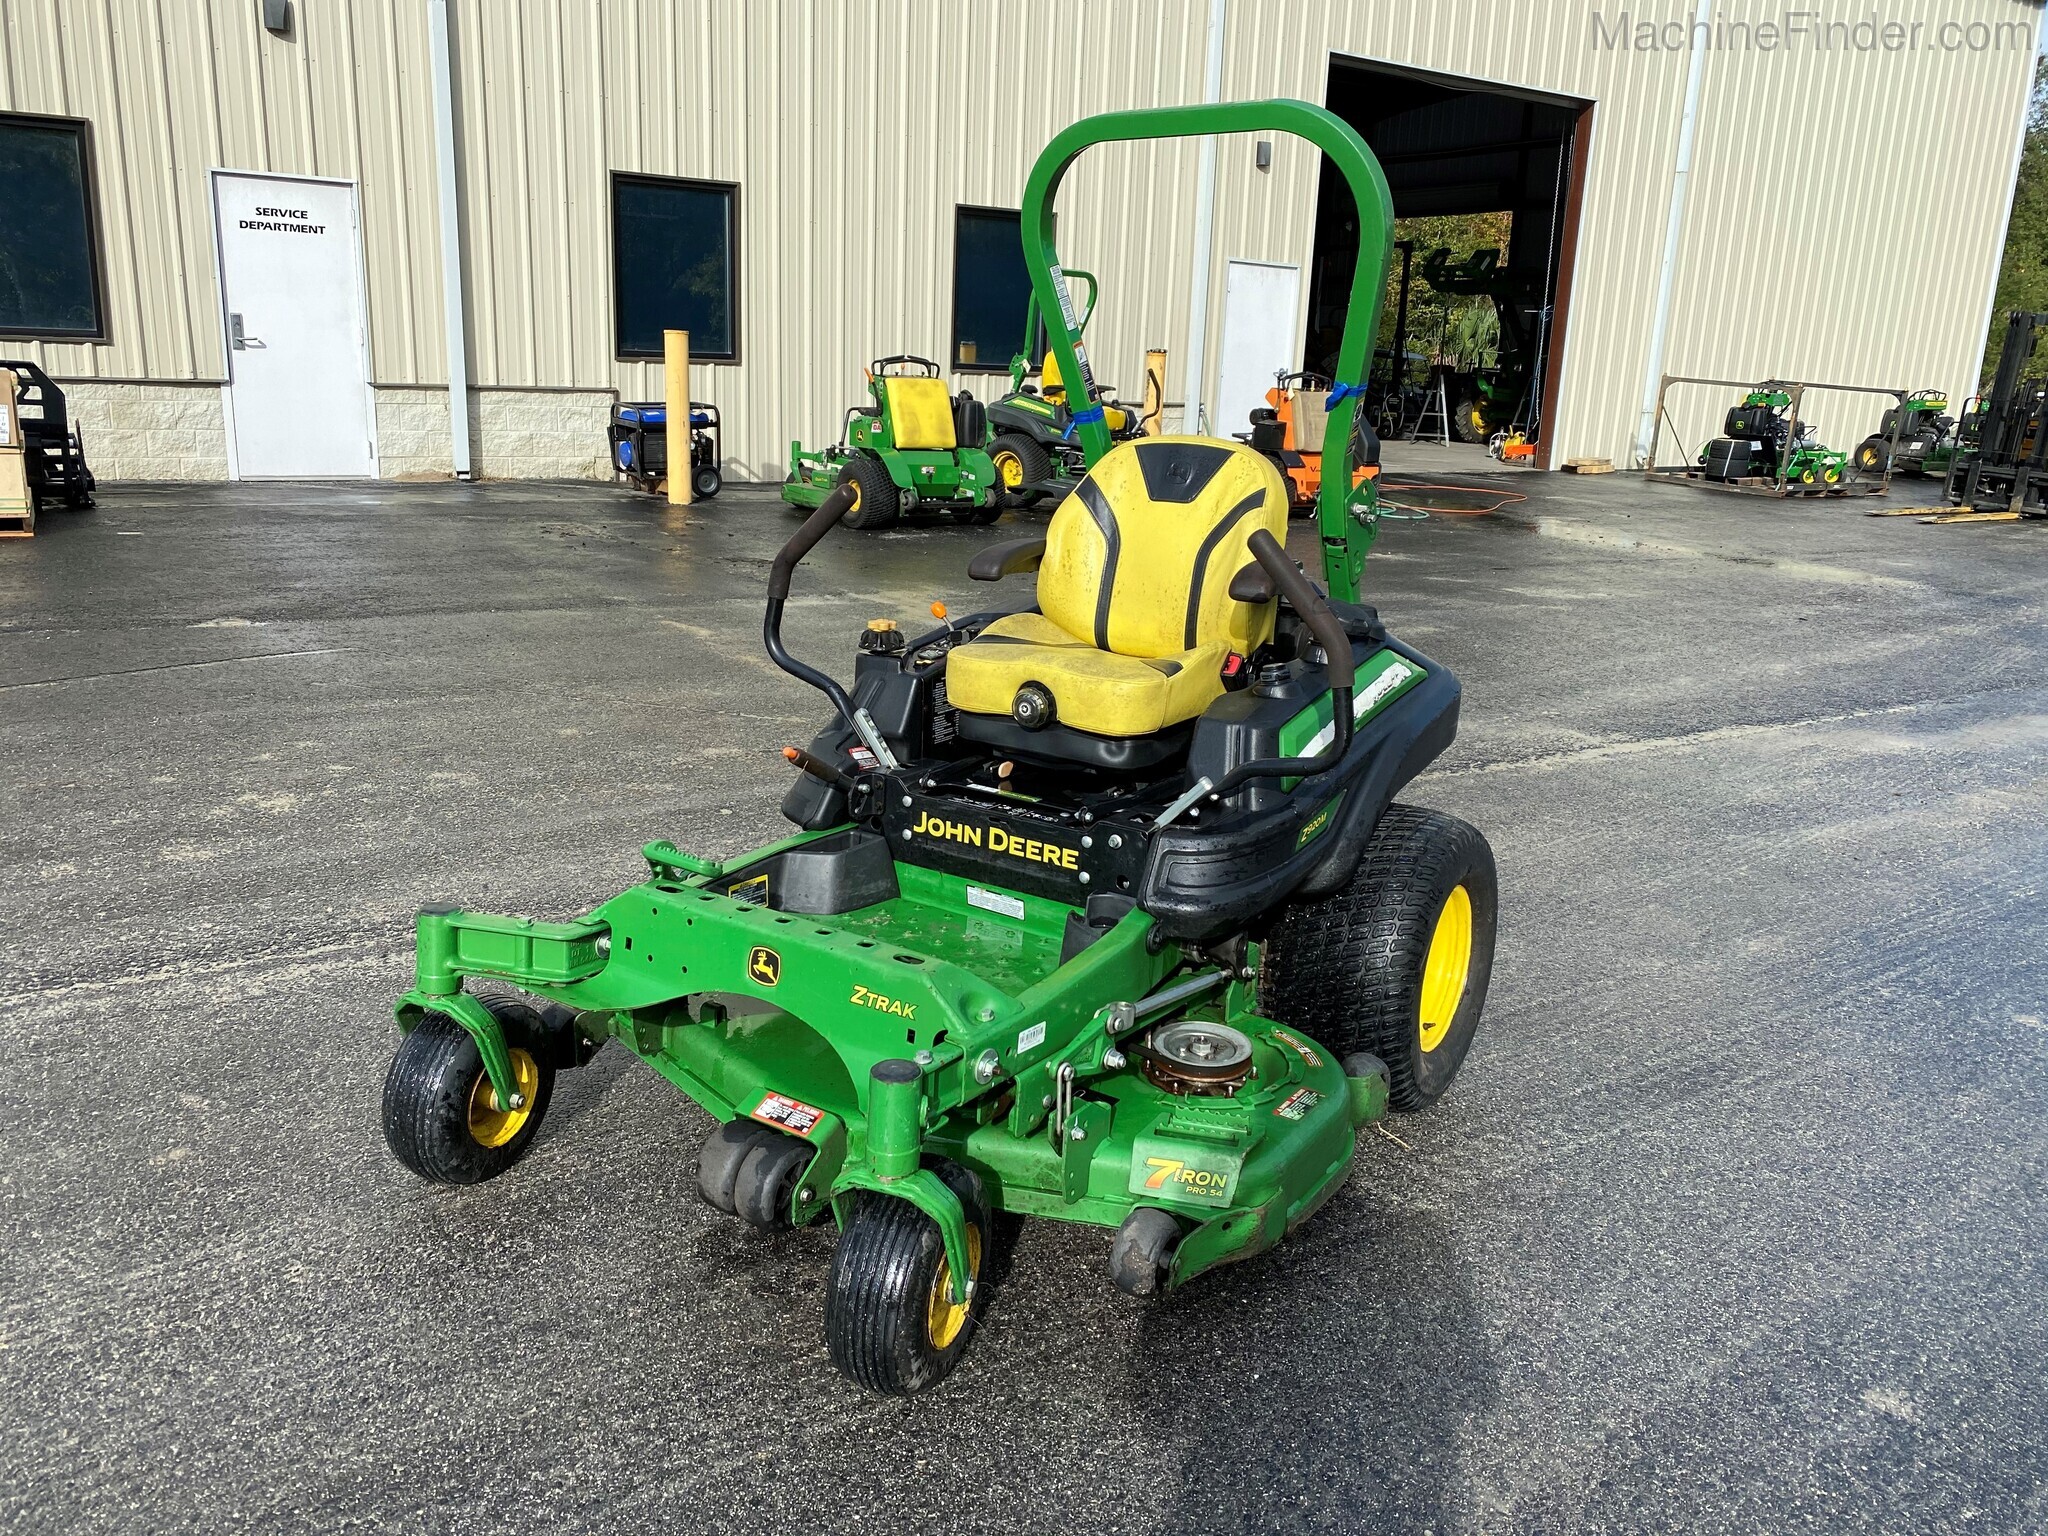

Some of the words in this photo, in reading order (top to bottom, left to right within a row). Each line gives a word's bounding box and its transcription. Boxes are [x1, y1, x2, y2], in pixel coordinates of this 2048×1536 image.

[255, 207, 308, 219] SERVICE
[239, 220, 326, 234] DEPARTMENT
[913, 811, 982, 847] JOHN
[988, 826, 1080, 871] DEERE
[850, 984, 919, 1020] ZTRAK
[1185, 1186, 1206, 1195] PRO
[1209, 1189, 1223, 1197] 54
